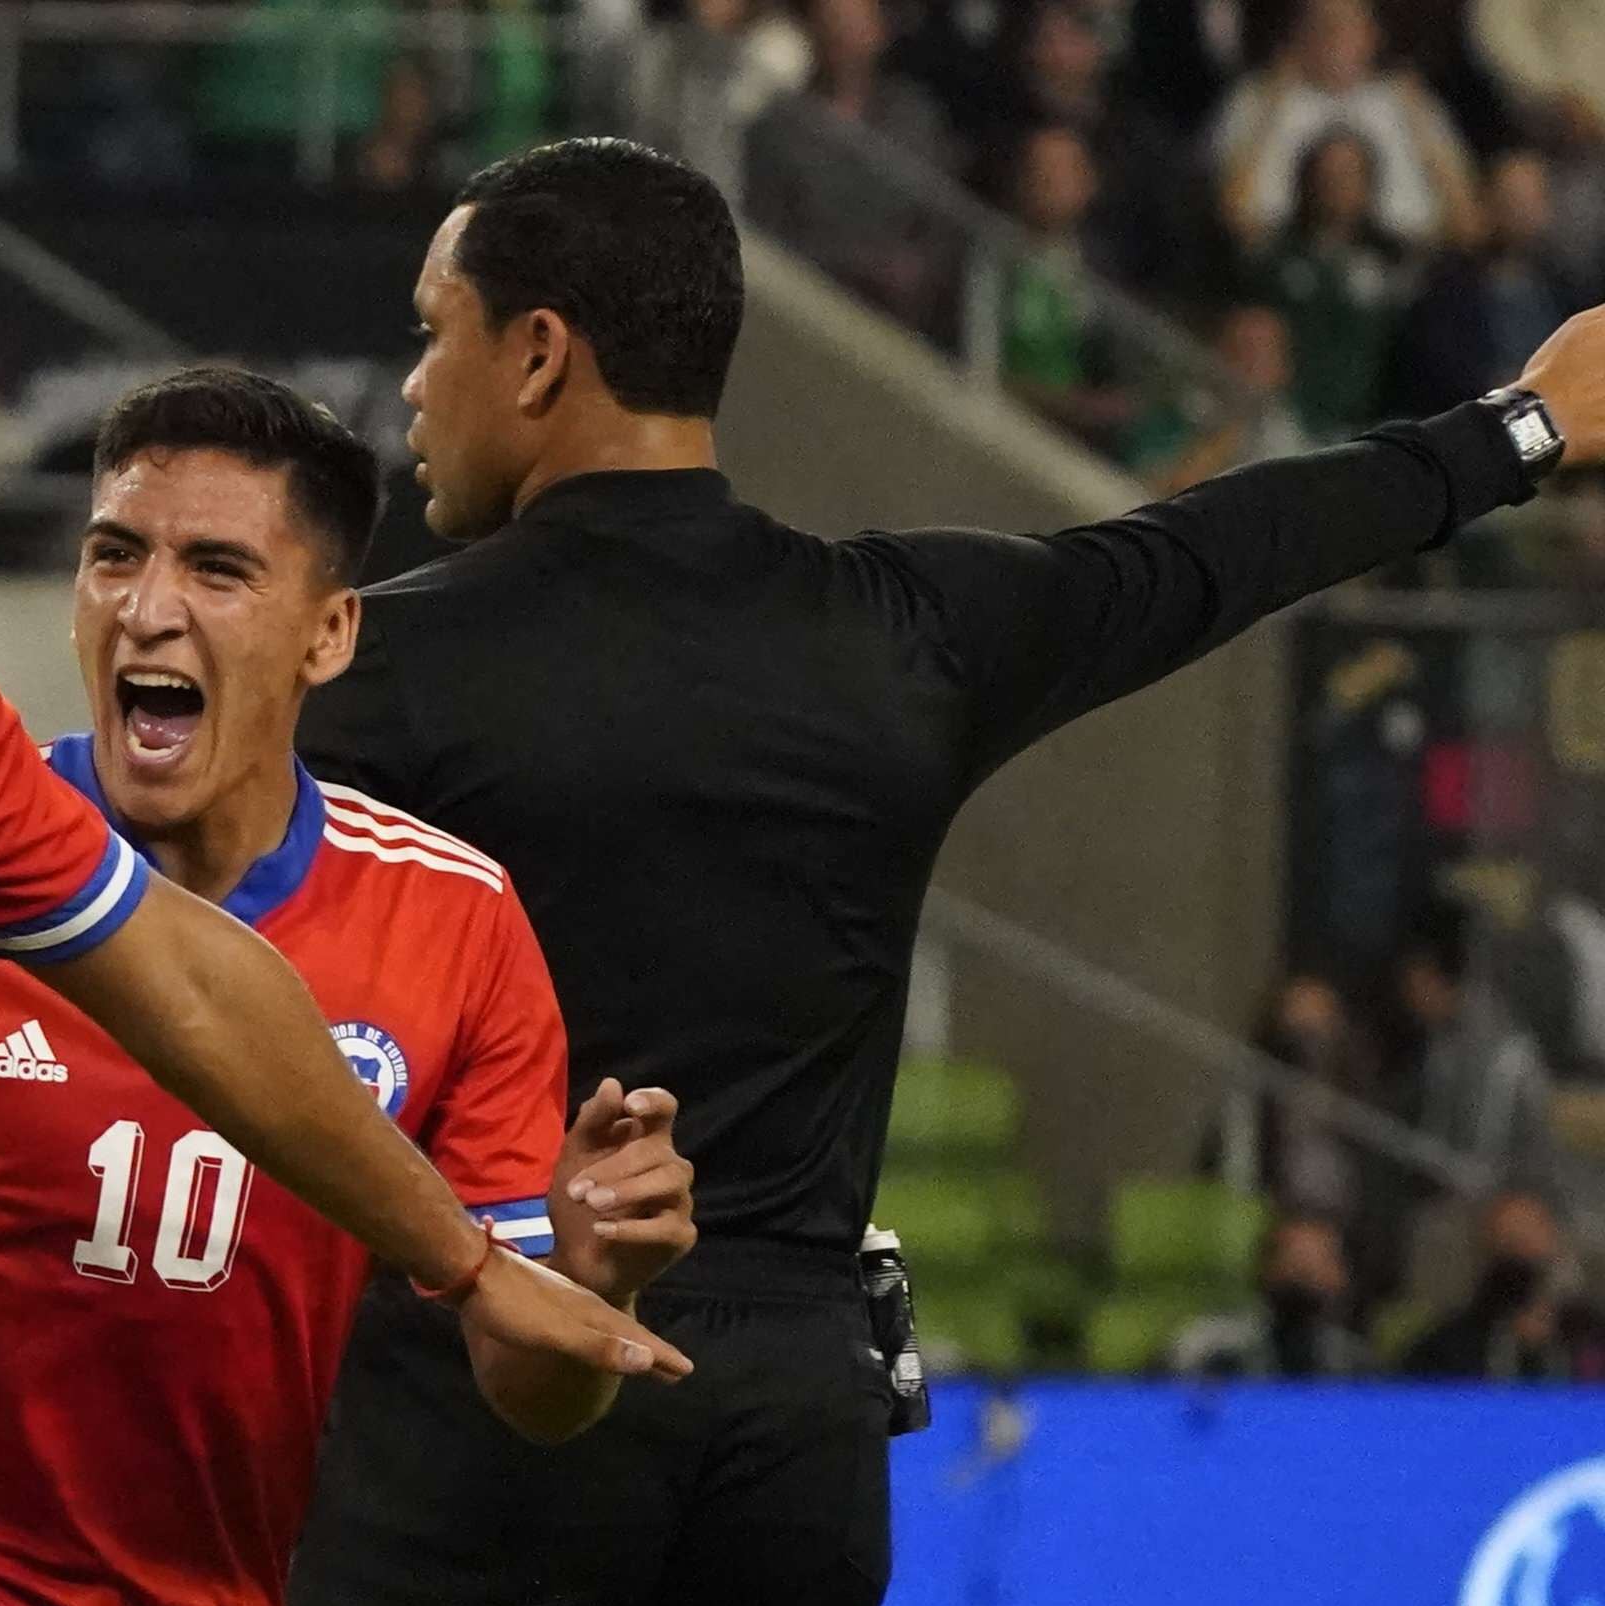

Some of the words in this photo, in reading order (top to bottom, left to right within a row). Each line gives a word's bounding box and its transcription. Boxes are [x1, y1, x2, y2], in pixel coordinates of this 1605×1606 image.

[365, 1026, 383, 1044] DE
[383, 1040, 408, 1088] FUTBOL
[73, 1119, 255, 1292] 10
